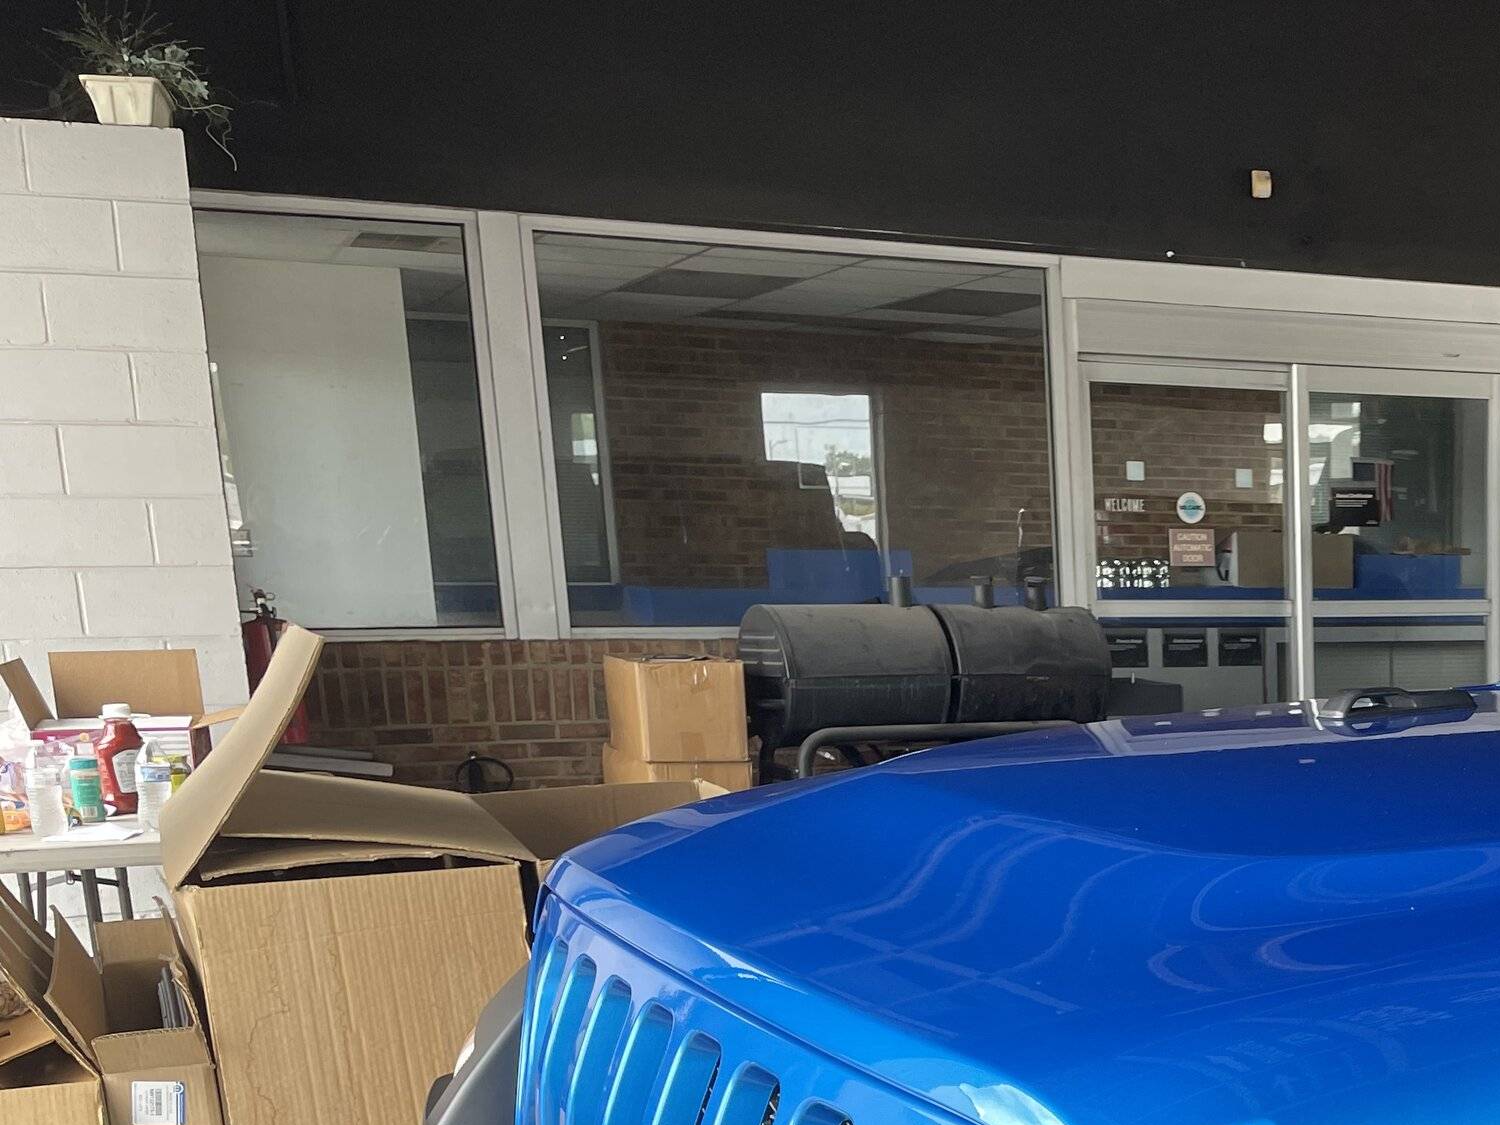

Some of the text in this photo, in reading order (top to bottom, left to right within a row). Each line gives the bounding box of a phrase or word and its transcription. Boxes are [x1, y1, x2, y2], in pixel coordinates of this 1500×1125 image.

[1104, 498, 1145, 512] WELCOME
[1177, 533, 1208, 541] CAUTION
[1173, 544, 1213, 552] AUTOMATIC
[1182, 554, 1204, 562] DOOR
